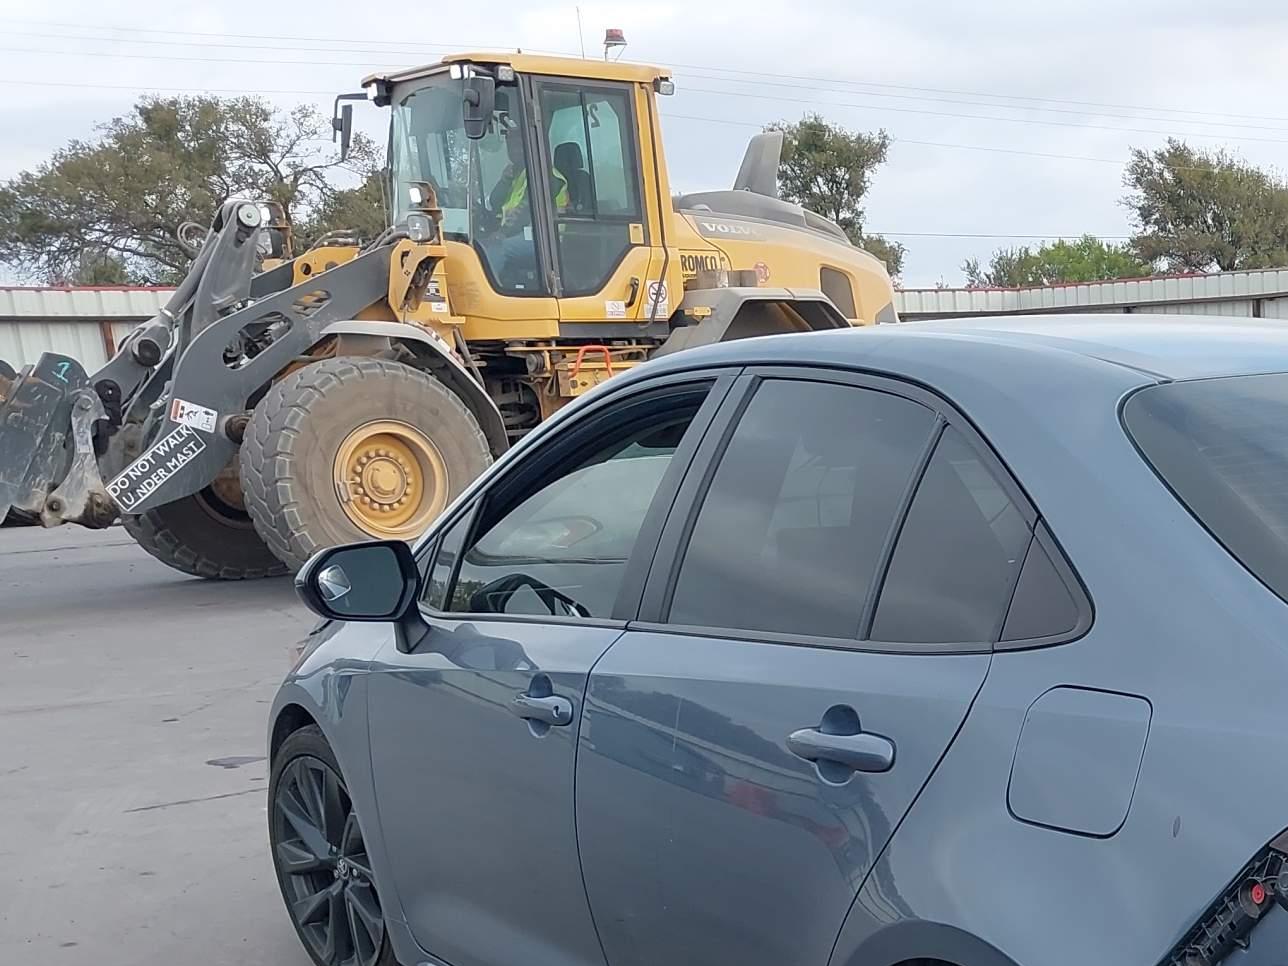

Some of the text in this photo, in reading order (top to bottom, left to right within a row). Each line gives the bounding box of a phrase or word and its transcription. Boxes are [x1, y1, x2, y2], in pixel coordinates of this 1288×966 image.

[108, 425, 192, 497] DO NOT WALK
[166, 441, 199, 472] MAST
